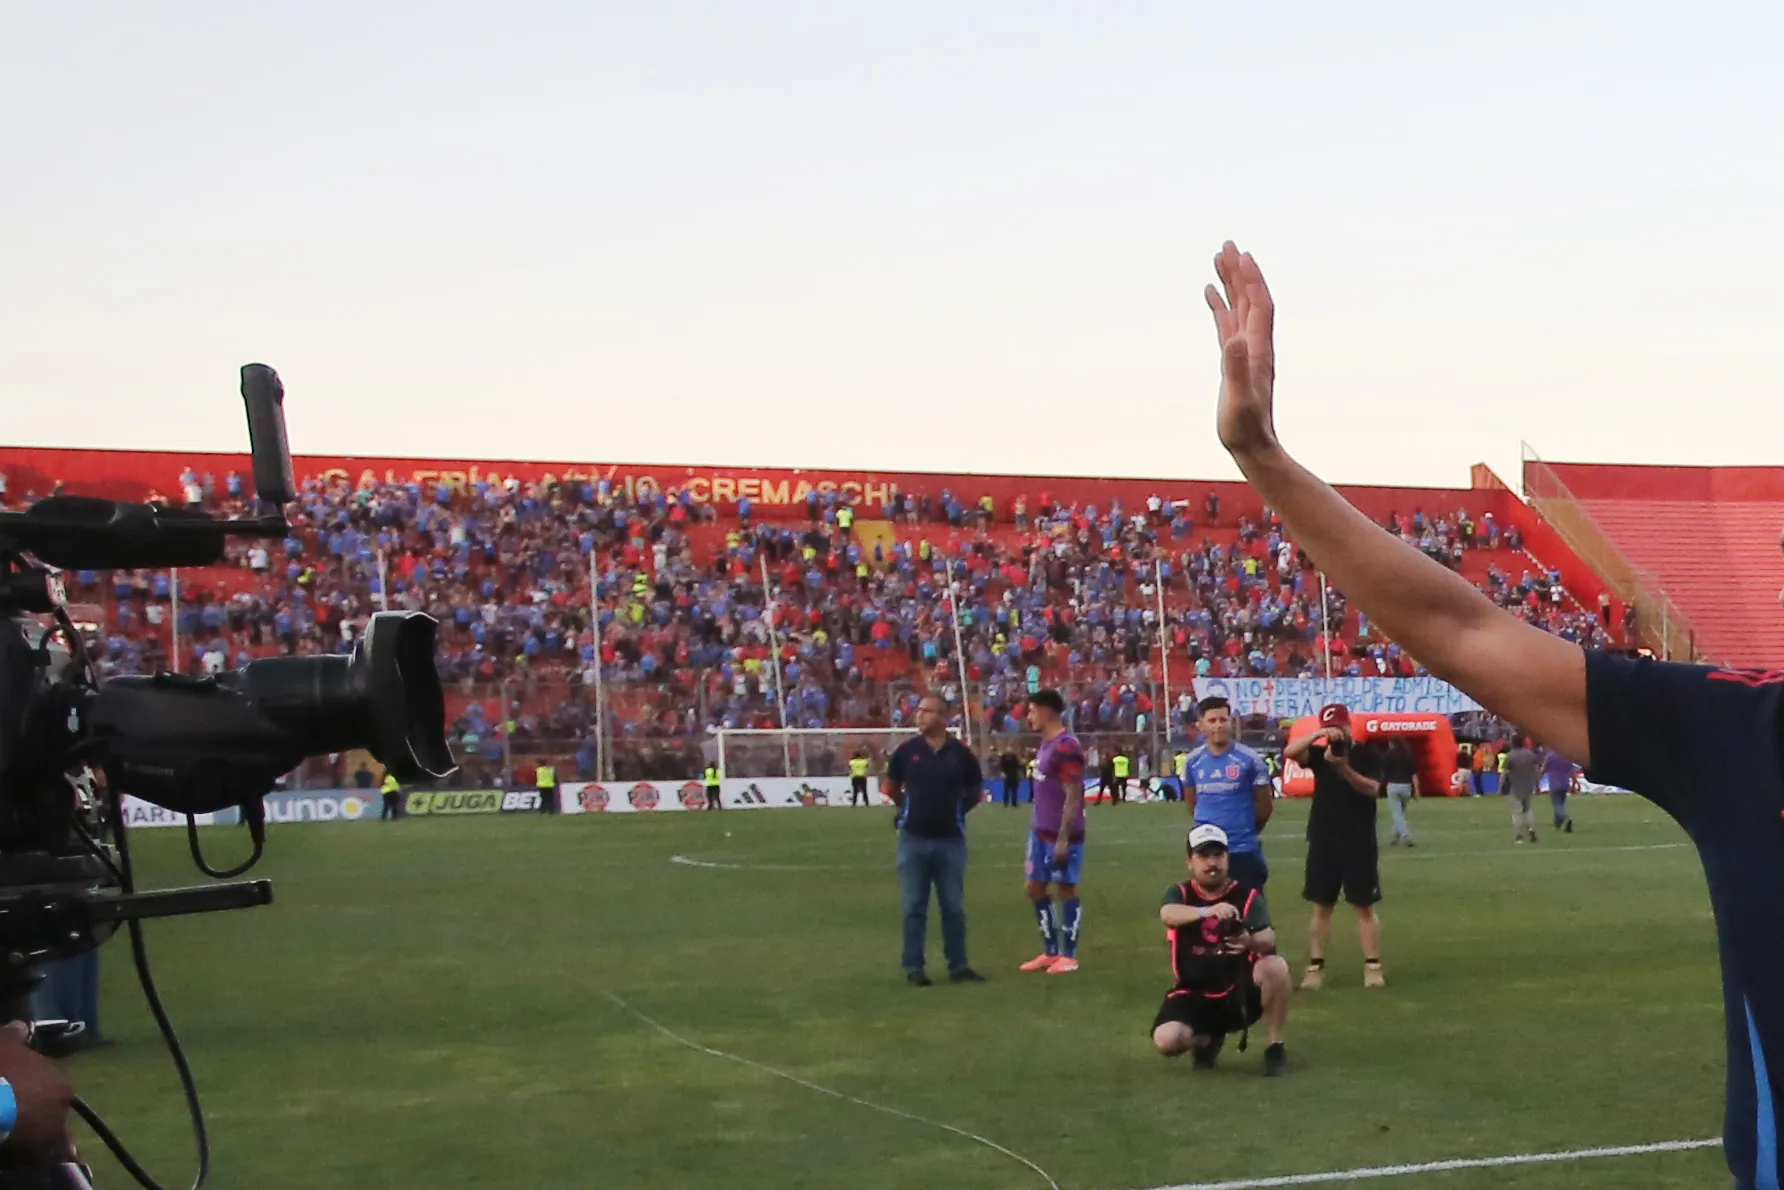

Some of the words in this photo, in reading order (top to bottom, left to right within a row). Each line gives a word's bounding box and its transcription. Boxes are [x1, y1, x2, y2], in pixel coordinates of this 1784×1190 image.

[688, 476, 897, 506] CREMASCHI
[1362, 678, 1383, 694] DE
[1380, 721, 1437, 732] GATORADE
